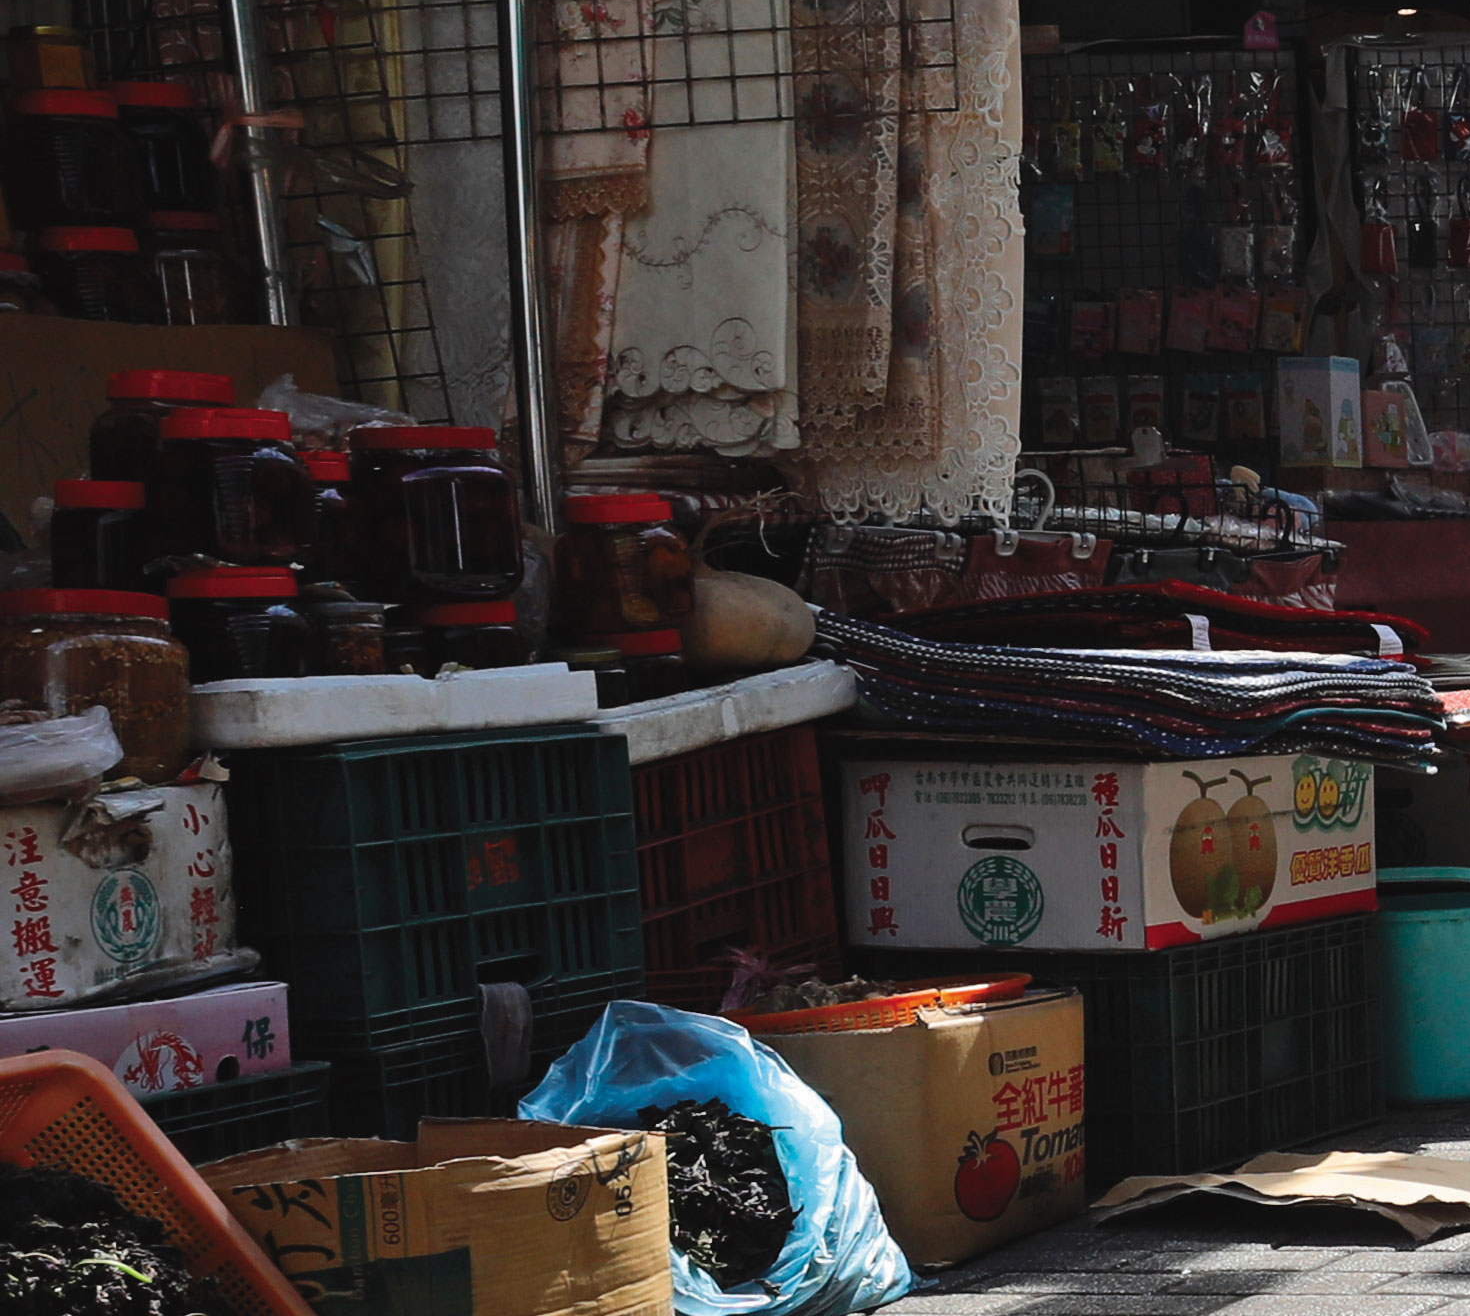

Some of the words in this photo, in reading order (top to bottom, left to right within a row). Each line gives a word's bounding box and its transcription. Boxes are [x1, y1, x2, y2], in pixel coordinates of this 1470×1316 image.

[4, 825, 64, 999] 注意搬運
[183, 801, 220, 965] 小心輕放
[1091, 771, 1129, 942] 種瓜日日新
[1289, 842, 1373, 887] 優質洋香瓜
[241, 1015, 275, 1062] 保
